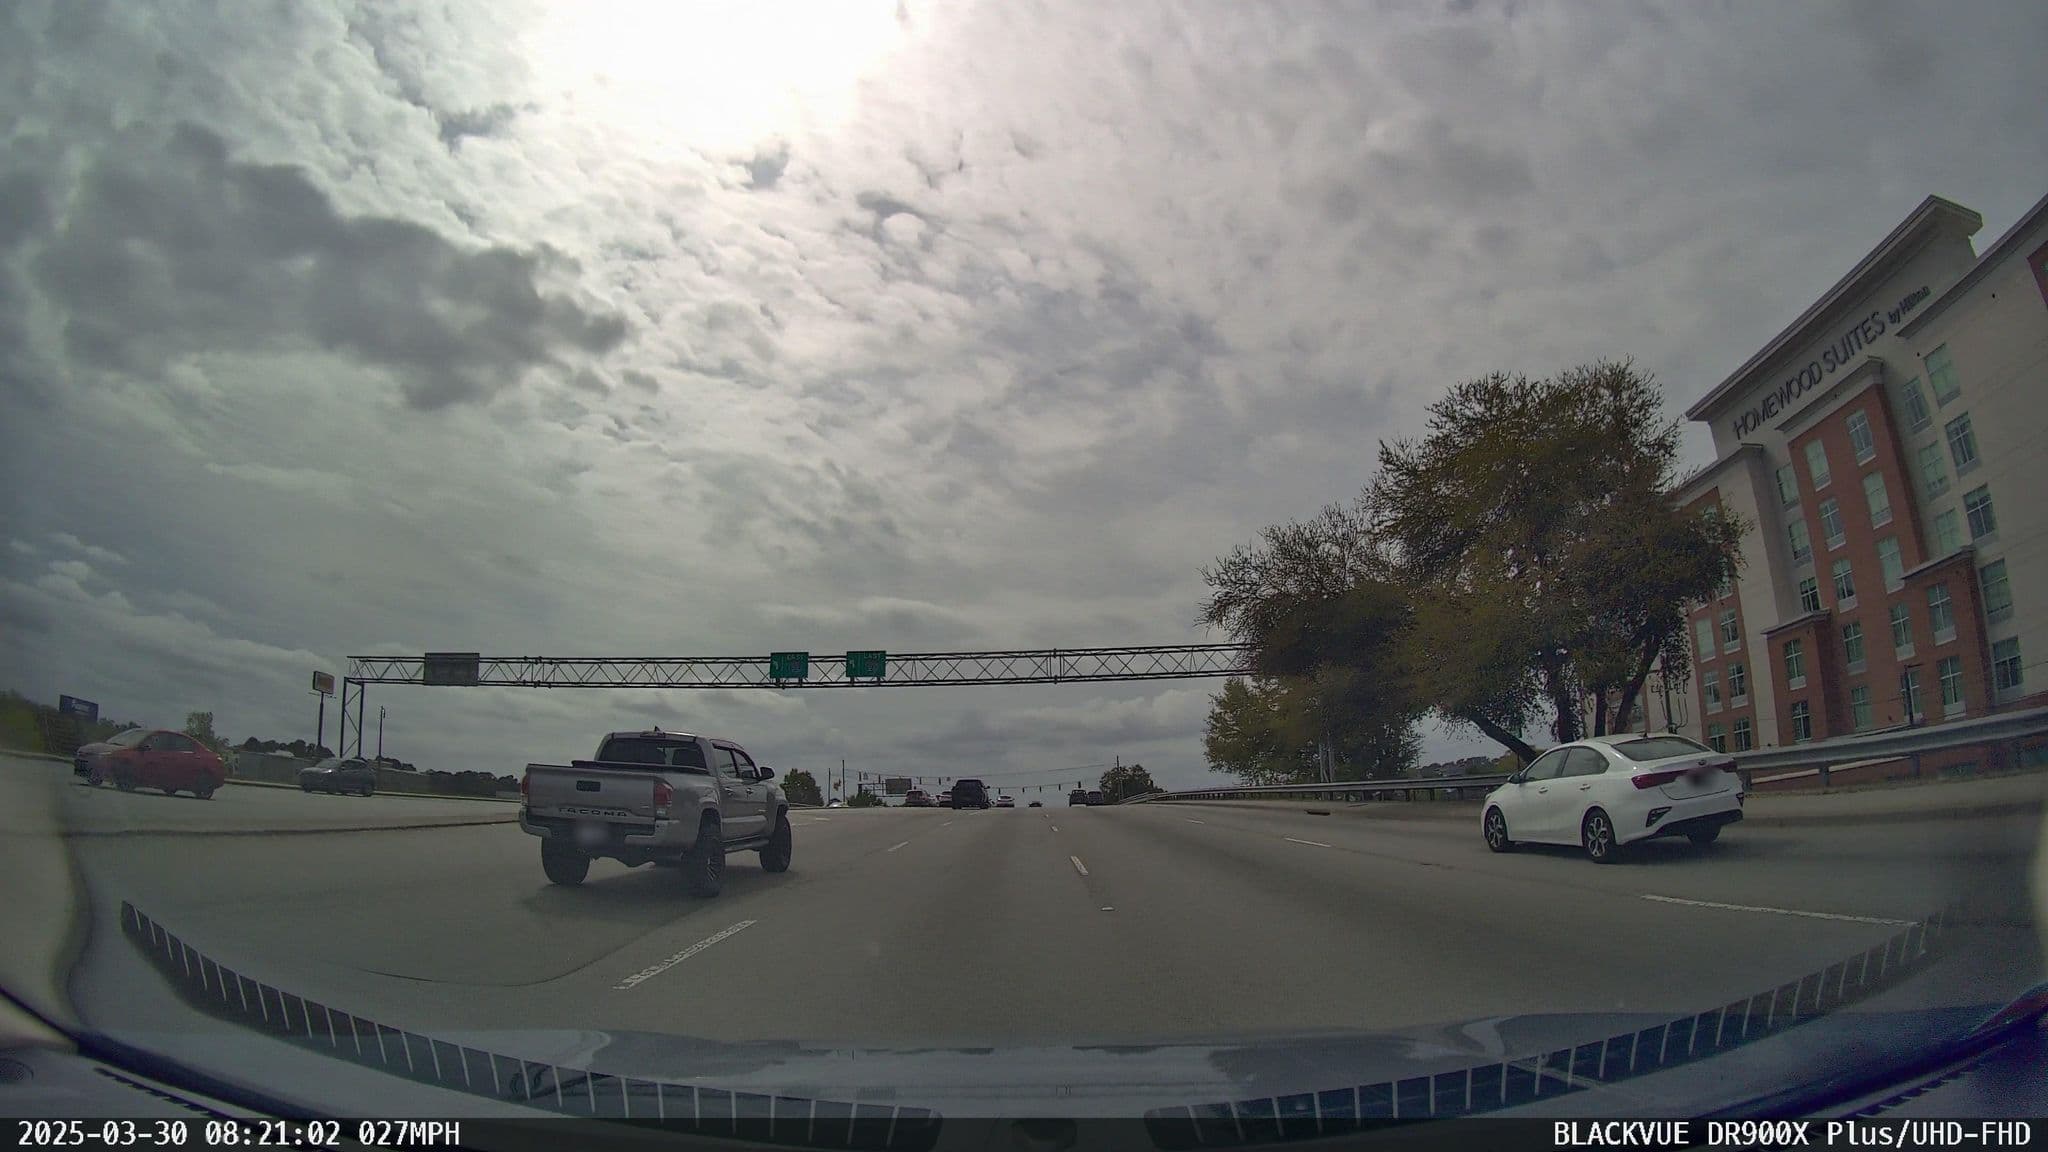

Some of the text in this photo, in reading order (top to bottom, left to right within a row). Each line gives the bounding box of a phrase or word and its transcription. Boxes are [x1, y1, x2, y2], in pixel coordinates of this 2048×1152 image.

[1732, 361, 1823, 440] HOMEWOOD
[1823, 311, 1886, 374] SUITES
[1887, 308, 1901, 324] by
[558, 807, 628, 817] TACOMA
